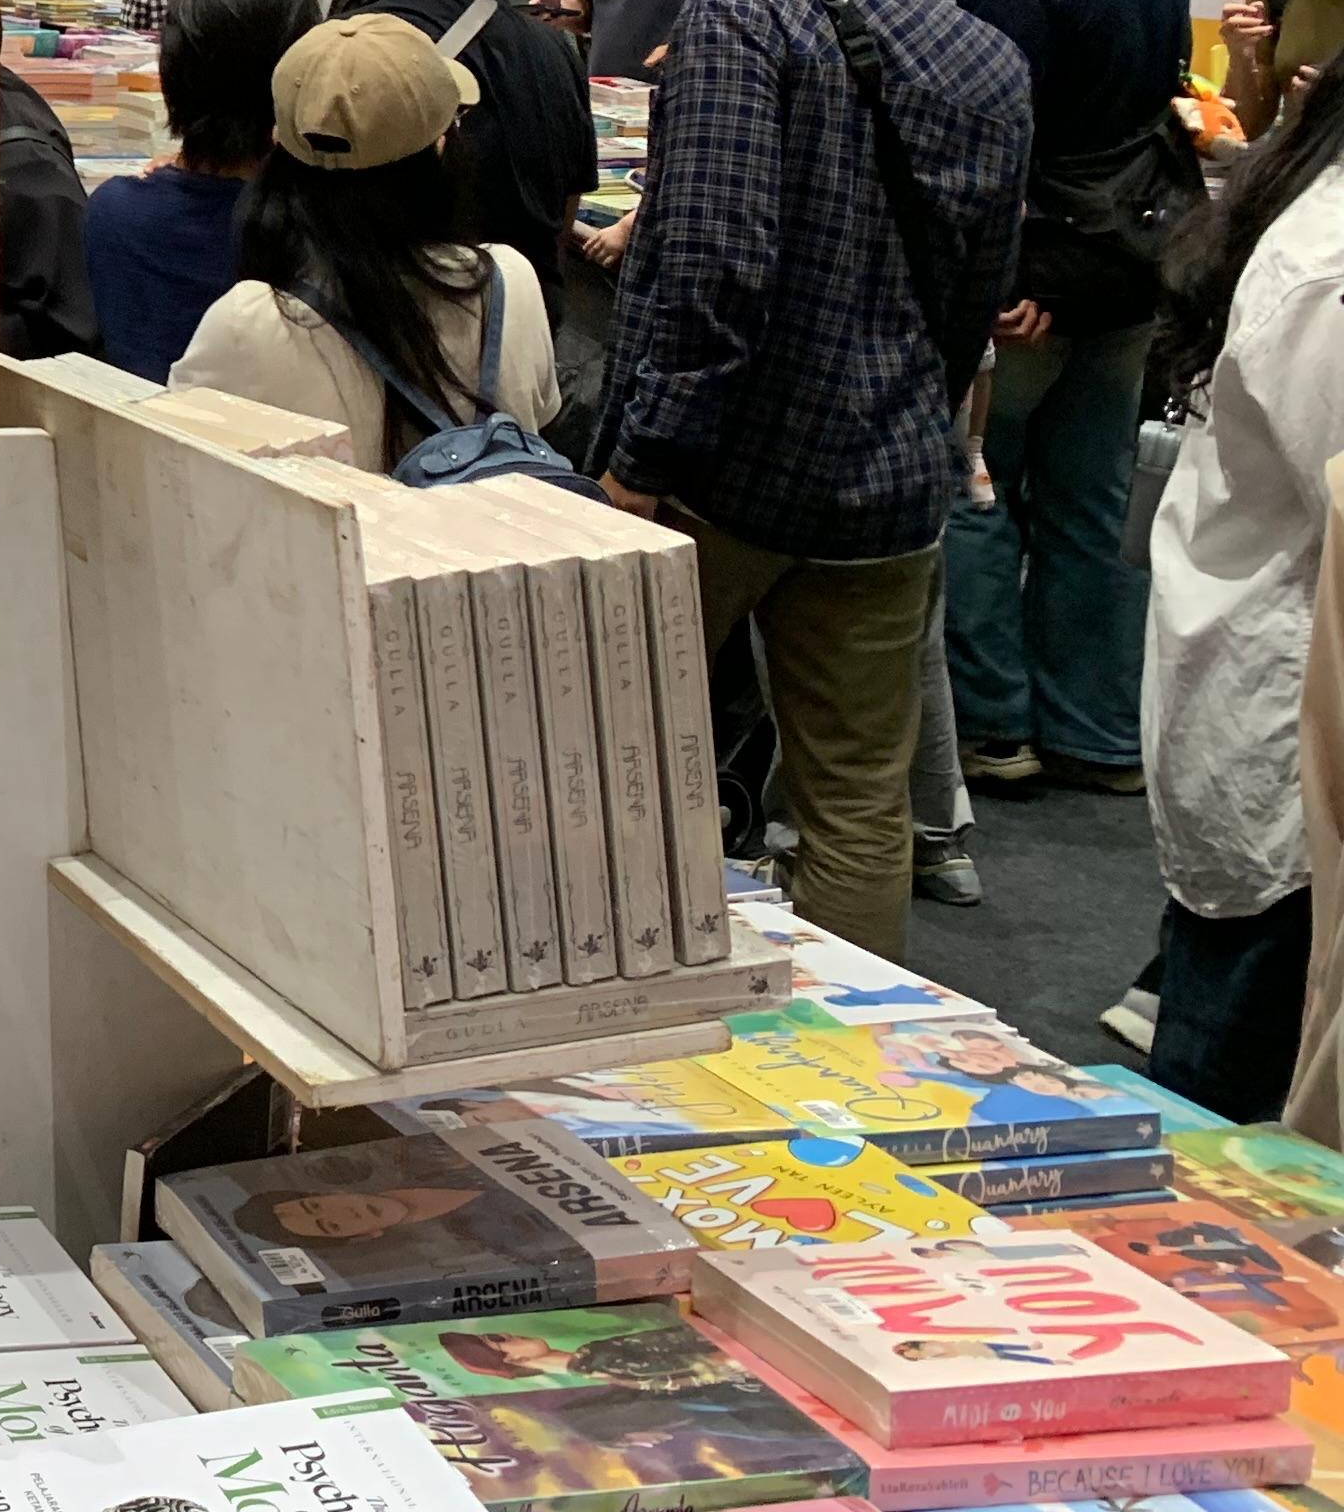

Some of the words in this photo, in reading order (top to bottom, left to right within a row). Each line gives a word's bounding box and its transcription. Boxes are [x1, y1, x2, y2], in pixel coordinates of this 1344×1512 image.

[553, 610, 573, 697] GULLA
[613, 604, 632, 691] GULLA
[385, 629, 406, 717] GULLA
[396, 771, 423, 850] ARSENA
[440, 624, 460, 712] GULLA
[451, 766, 477, 845] ARSENA
[497, 617, 517, 705] GULLA
[507, 758, 533, 835] ARSENA
[670, 594, 689, 680] GULLA
[680, 733, 705, 812] ARSENA
[562, 750, 588, 829] ARSENA
[622, 744, 647, 823] ARSENA
[574, 993, 651, 1022] ARSENA
[757, 1033, 942, 1121] Quandary
[771, 1163, 803, 1182] TAN
[941, 1121, 1051, 1162] Quandary
[477, 1141, 640, 1228] ARSENA
[815, 1182, 897, 1213] AYLEEN
[957, 1164, 1064, 1203] Quandary
[451, 1277, 543, 1314] ARSENA
[978, 1265, 1203, 1359] YOU
[44, 1421, 74, 1437] of
[1029, 1400, 1067, 1423] YOU
[1027, 1465, 1134, 1496] BECAUSE
[1143, 1464, 1151, 1487] I
[1159, 1460, 1214, 1487] LOVE
[1222, 1454, 1265, 1478] YOU
